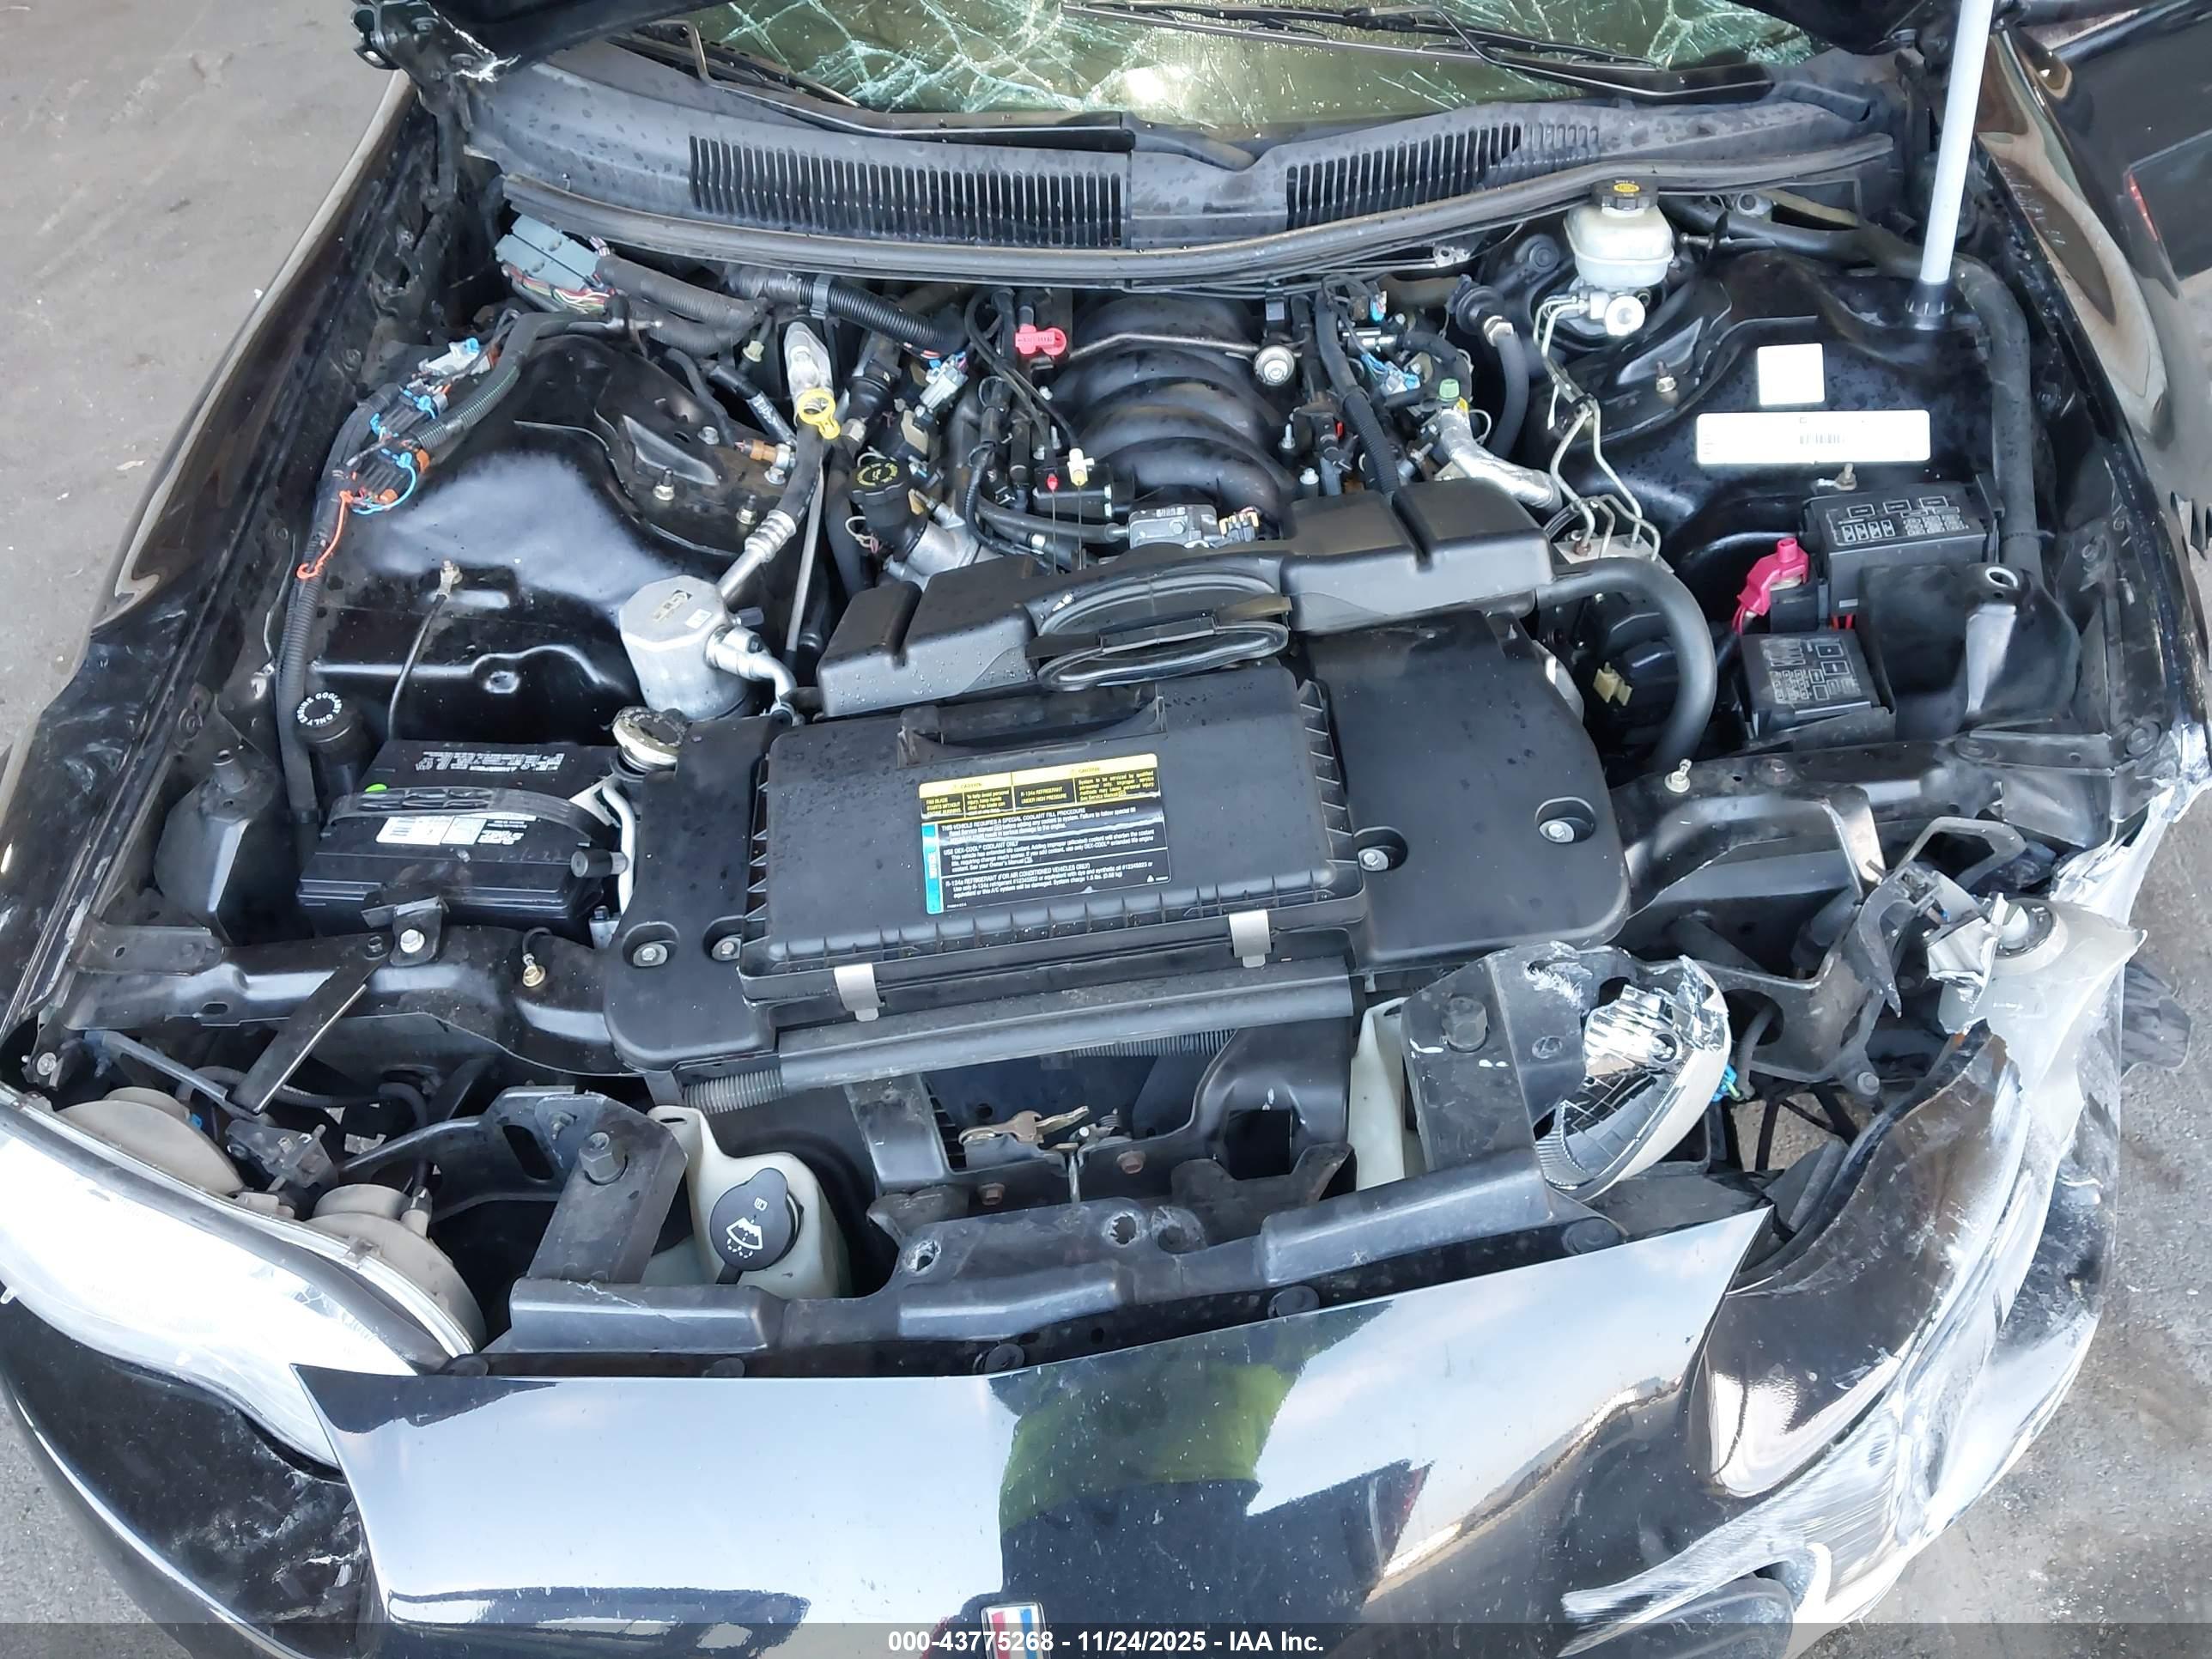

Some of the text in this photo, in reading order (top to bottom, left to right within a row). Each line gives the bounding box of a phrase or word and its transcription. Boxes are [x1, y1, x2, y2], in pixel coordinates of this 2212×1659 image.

[296, 691, 343, 726] ENGINE COOLANT ONLY
[964, 875, 998, 884] REFRIGERANT
